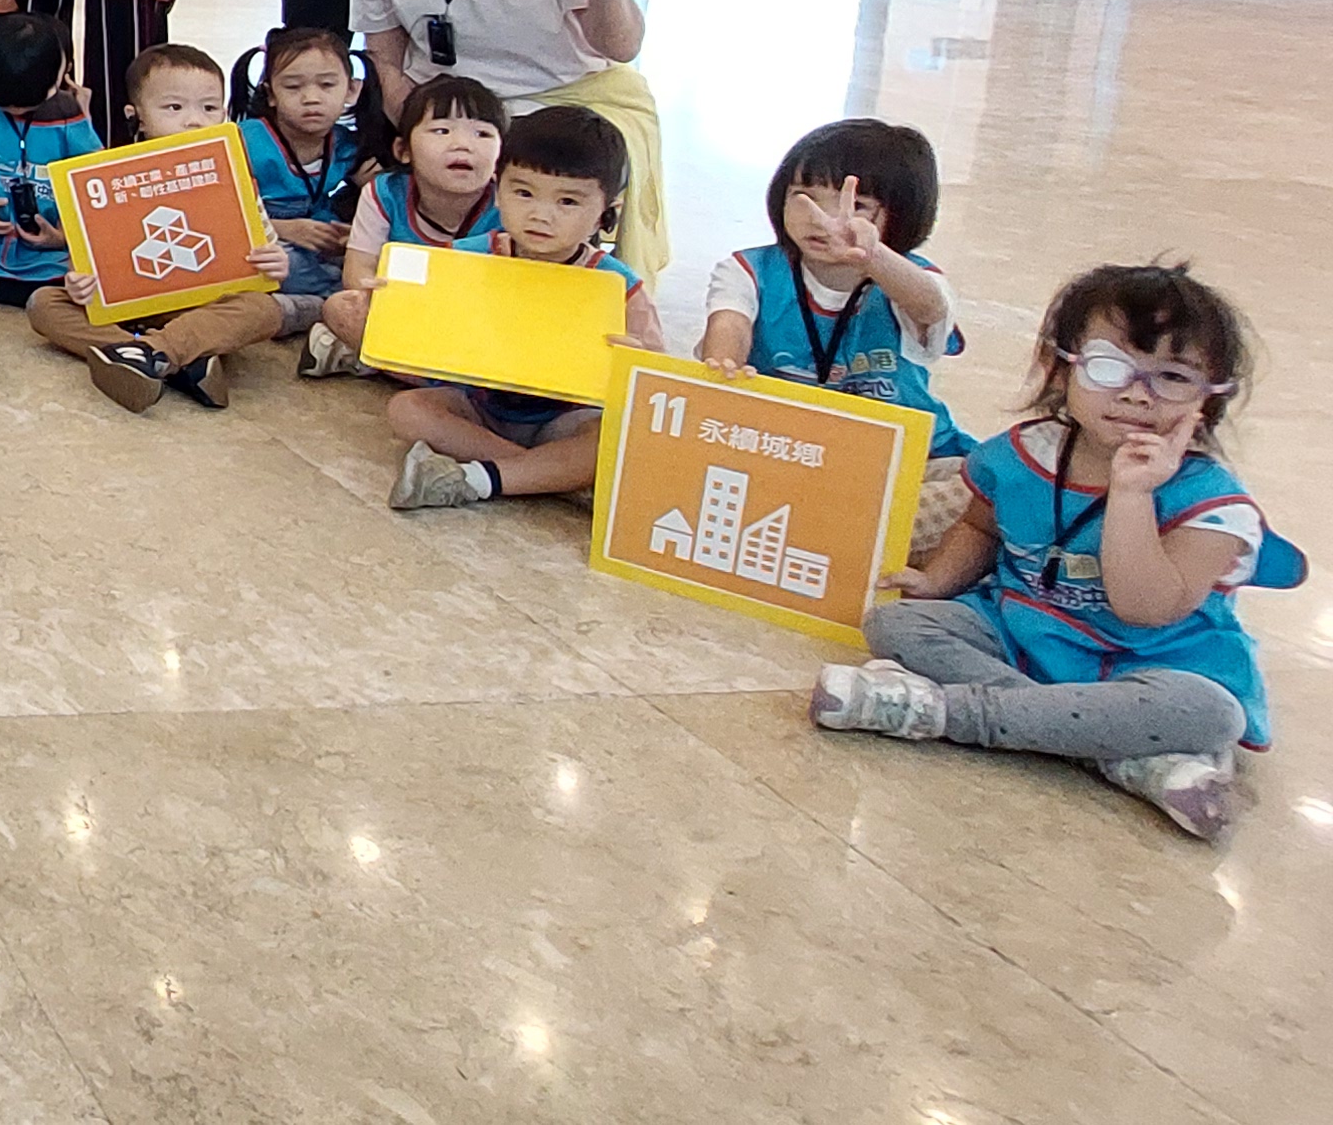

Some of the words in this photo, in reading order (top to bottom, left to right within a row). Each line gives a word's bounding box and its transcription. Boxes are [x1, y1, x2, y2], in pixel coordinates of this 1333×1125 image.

[86, 178, 108, 208] 9
[648, 392, 687, 438] 11
[697, 417, 826, 468] 永續城鄉
